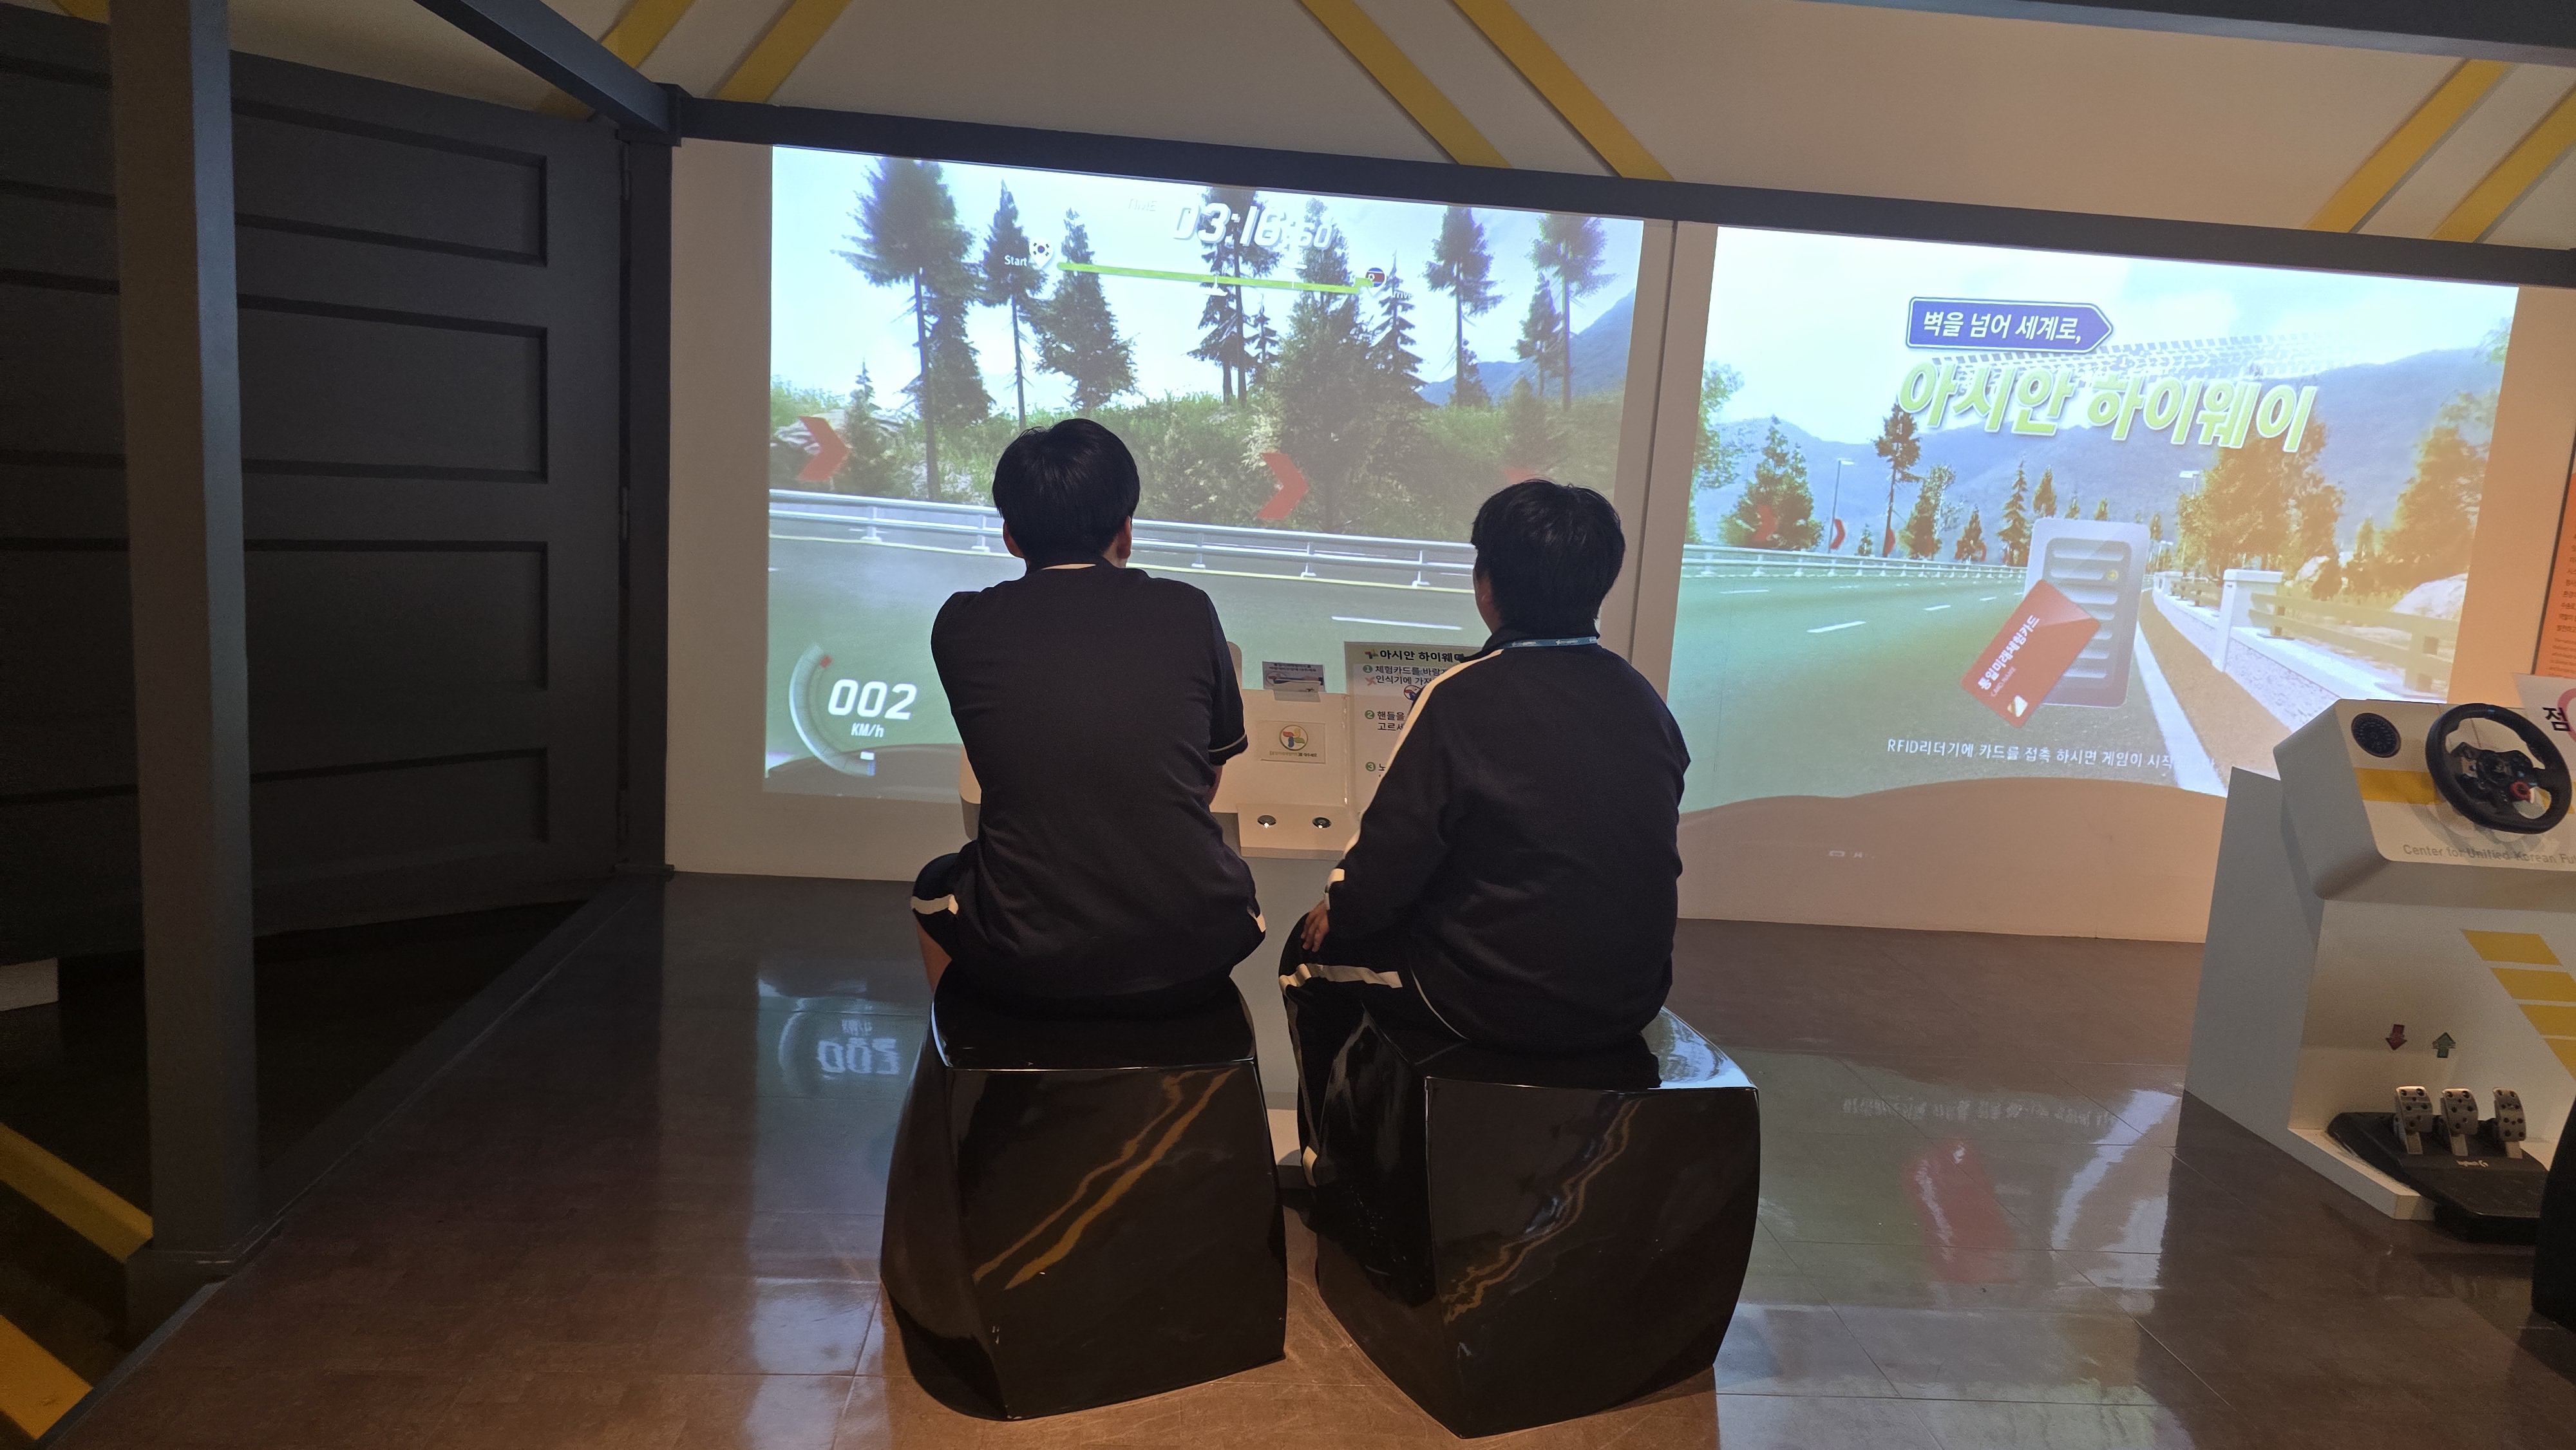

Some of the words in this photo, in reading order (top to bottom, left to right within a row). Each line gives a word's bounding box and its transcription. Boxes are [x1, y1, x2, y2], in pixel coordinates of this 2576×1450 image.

[1004, 254, 1028, 267] Start
[1923, 311, 1964, 337] 벽을
[1970, 312, 2012, 339] 넘어
[2014, 315, 2082, 344] 세계로,
[1897, 362, 2077, 437] 아시안
[2086, 372, 2318, 453] 하이웨이
[1379, 650, 1416, 661] 아시안
[1376, 675, 1412, 685] 인식기에
[828, 679, 918, 720] 002
[1377, 711, 1405, 721] 핸들을
[2542, 707, 2571, 731] 점
[851, 722, 885, 738] KM/h
[1887, 738, 1975, 758] RFID리더기에
[1979, 743, 2020, 760] 카드를
[2025, 747, 2051, 763] 접촉
[2056, 749, 2097, 765] 하시면
[2101, 750, 2143, 767] 게임이
[2403, 844, 2443, 857] Center
[2446, 846, 2464, 858] for
[2466, 846, 2510, 860] Unified
[2514, 850, 2557, 864] Korean
